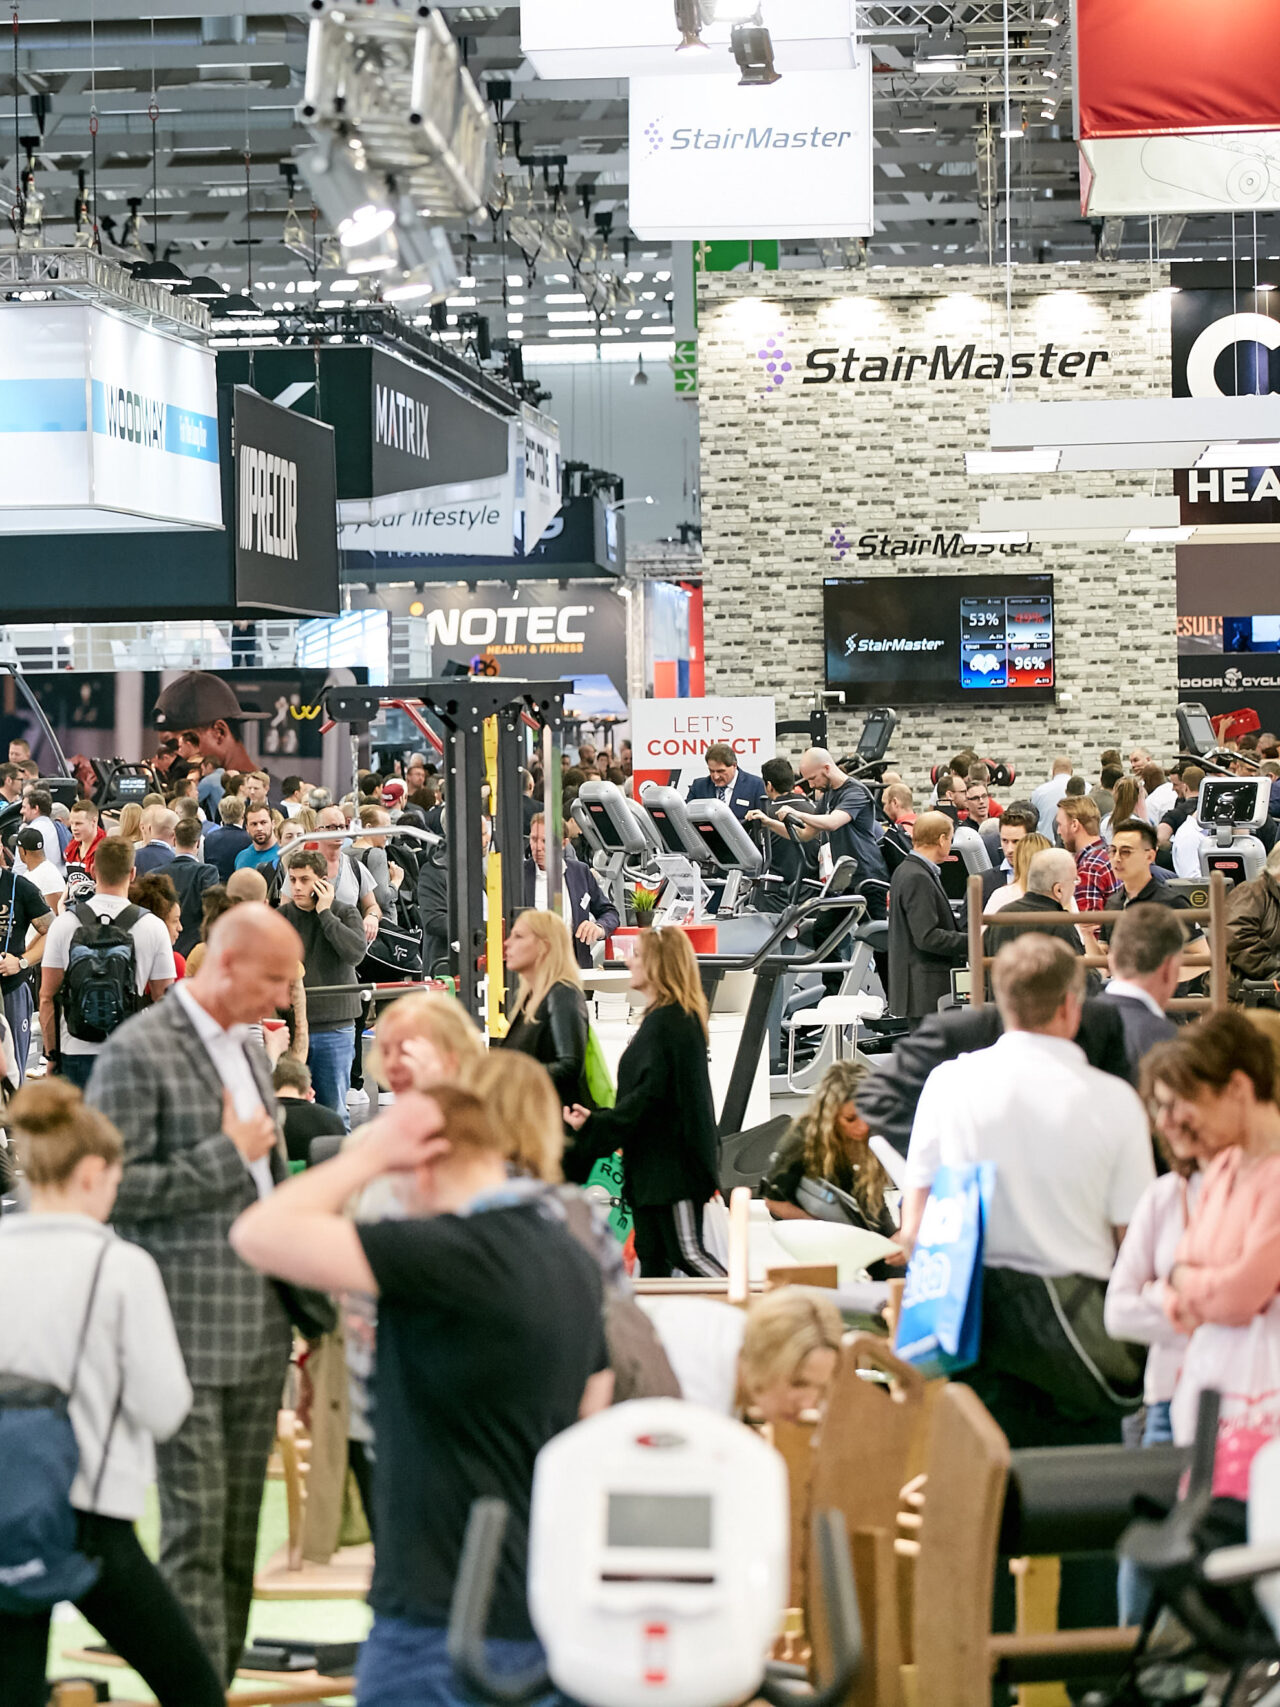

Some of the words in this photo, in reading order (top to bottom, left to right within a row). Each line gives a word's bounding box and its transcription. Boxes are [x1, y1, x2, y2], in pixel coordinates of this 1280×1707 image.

[670, 127, 852, 150] StairMaster
[802, 342, 1110, 385] StairMaster
[106, 383, 165, 450] WOODWAY
[376, 384, 430, 461] MATRIX
[239, 444, 299, 561] PRECOR
[969, 612, 1000, 627] 53%
[486, 645, 527, 656] HEALTH
[539, 643, 584, 655] FITNESS
[857, 637, 945, 653] StairMaster
[1014, 656, 1046, 671] 96%
[1178, 678, 1223, 688] DOOR
[673, 715, 734, 733] LET'S
[647, 737, 761, 756] CONNCT
